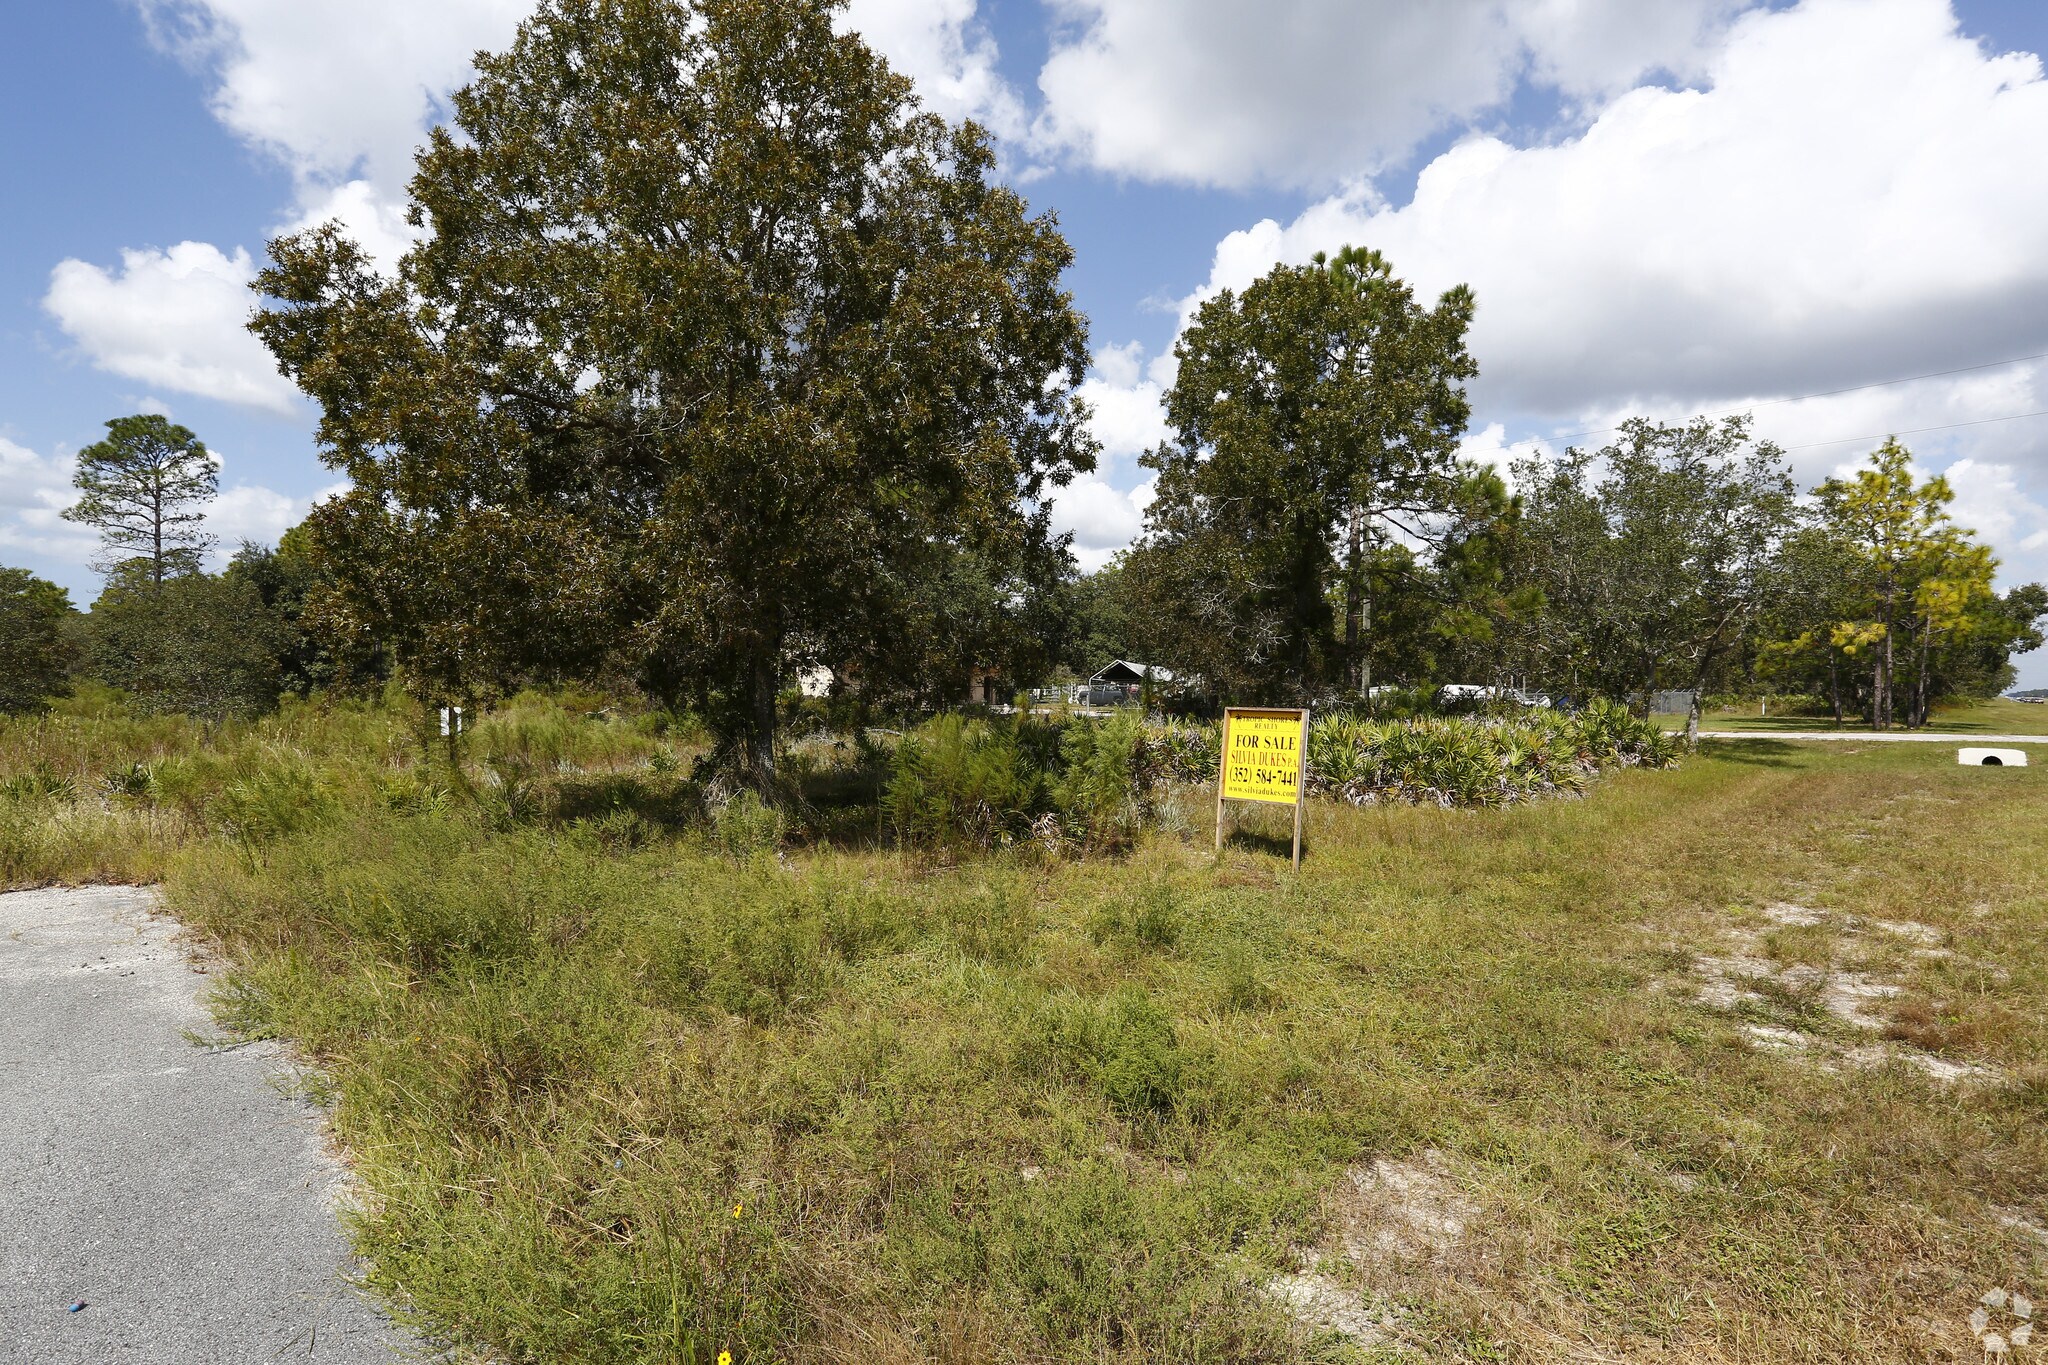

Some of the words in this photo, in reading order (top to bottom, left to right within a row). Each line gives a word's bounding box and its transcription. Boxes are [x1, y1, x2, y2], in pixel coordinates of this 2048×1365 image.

[1236, 735, 1259, 748] FOR
[1264, 736, 1296, 750] SALE
[1231, 750, 1255, 764] SILVIA
[1259, 752, 1286, 767] DUKES
[1230, 765, 1252, 784] (352)
[1256, 769, 1296, 786] 584-7441
[1228, 786, 1296, 798] www.silviadukes.com
